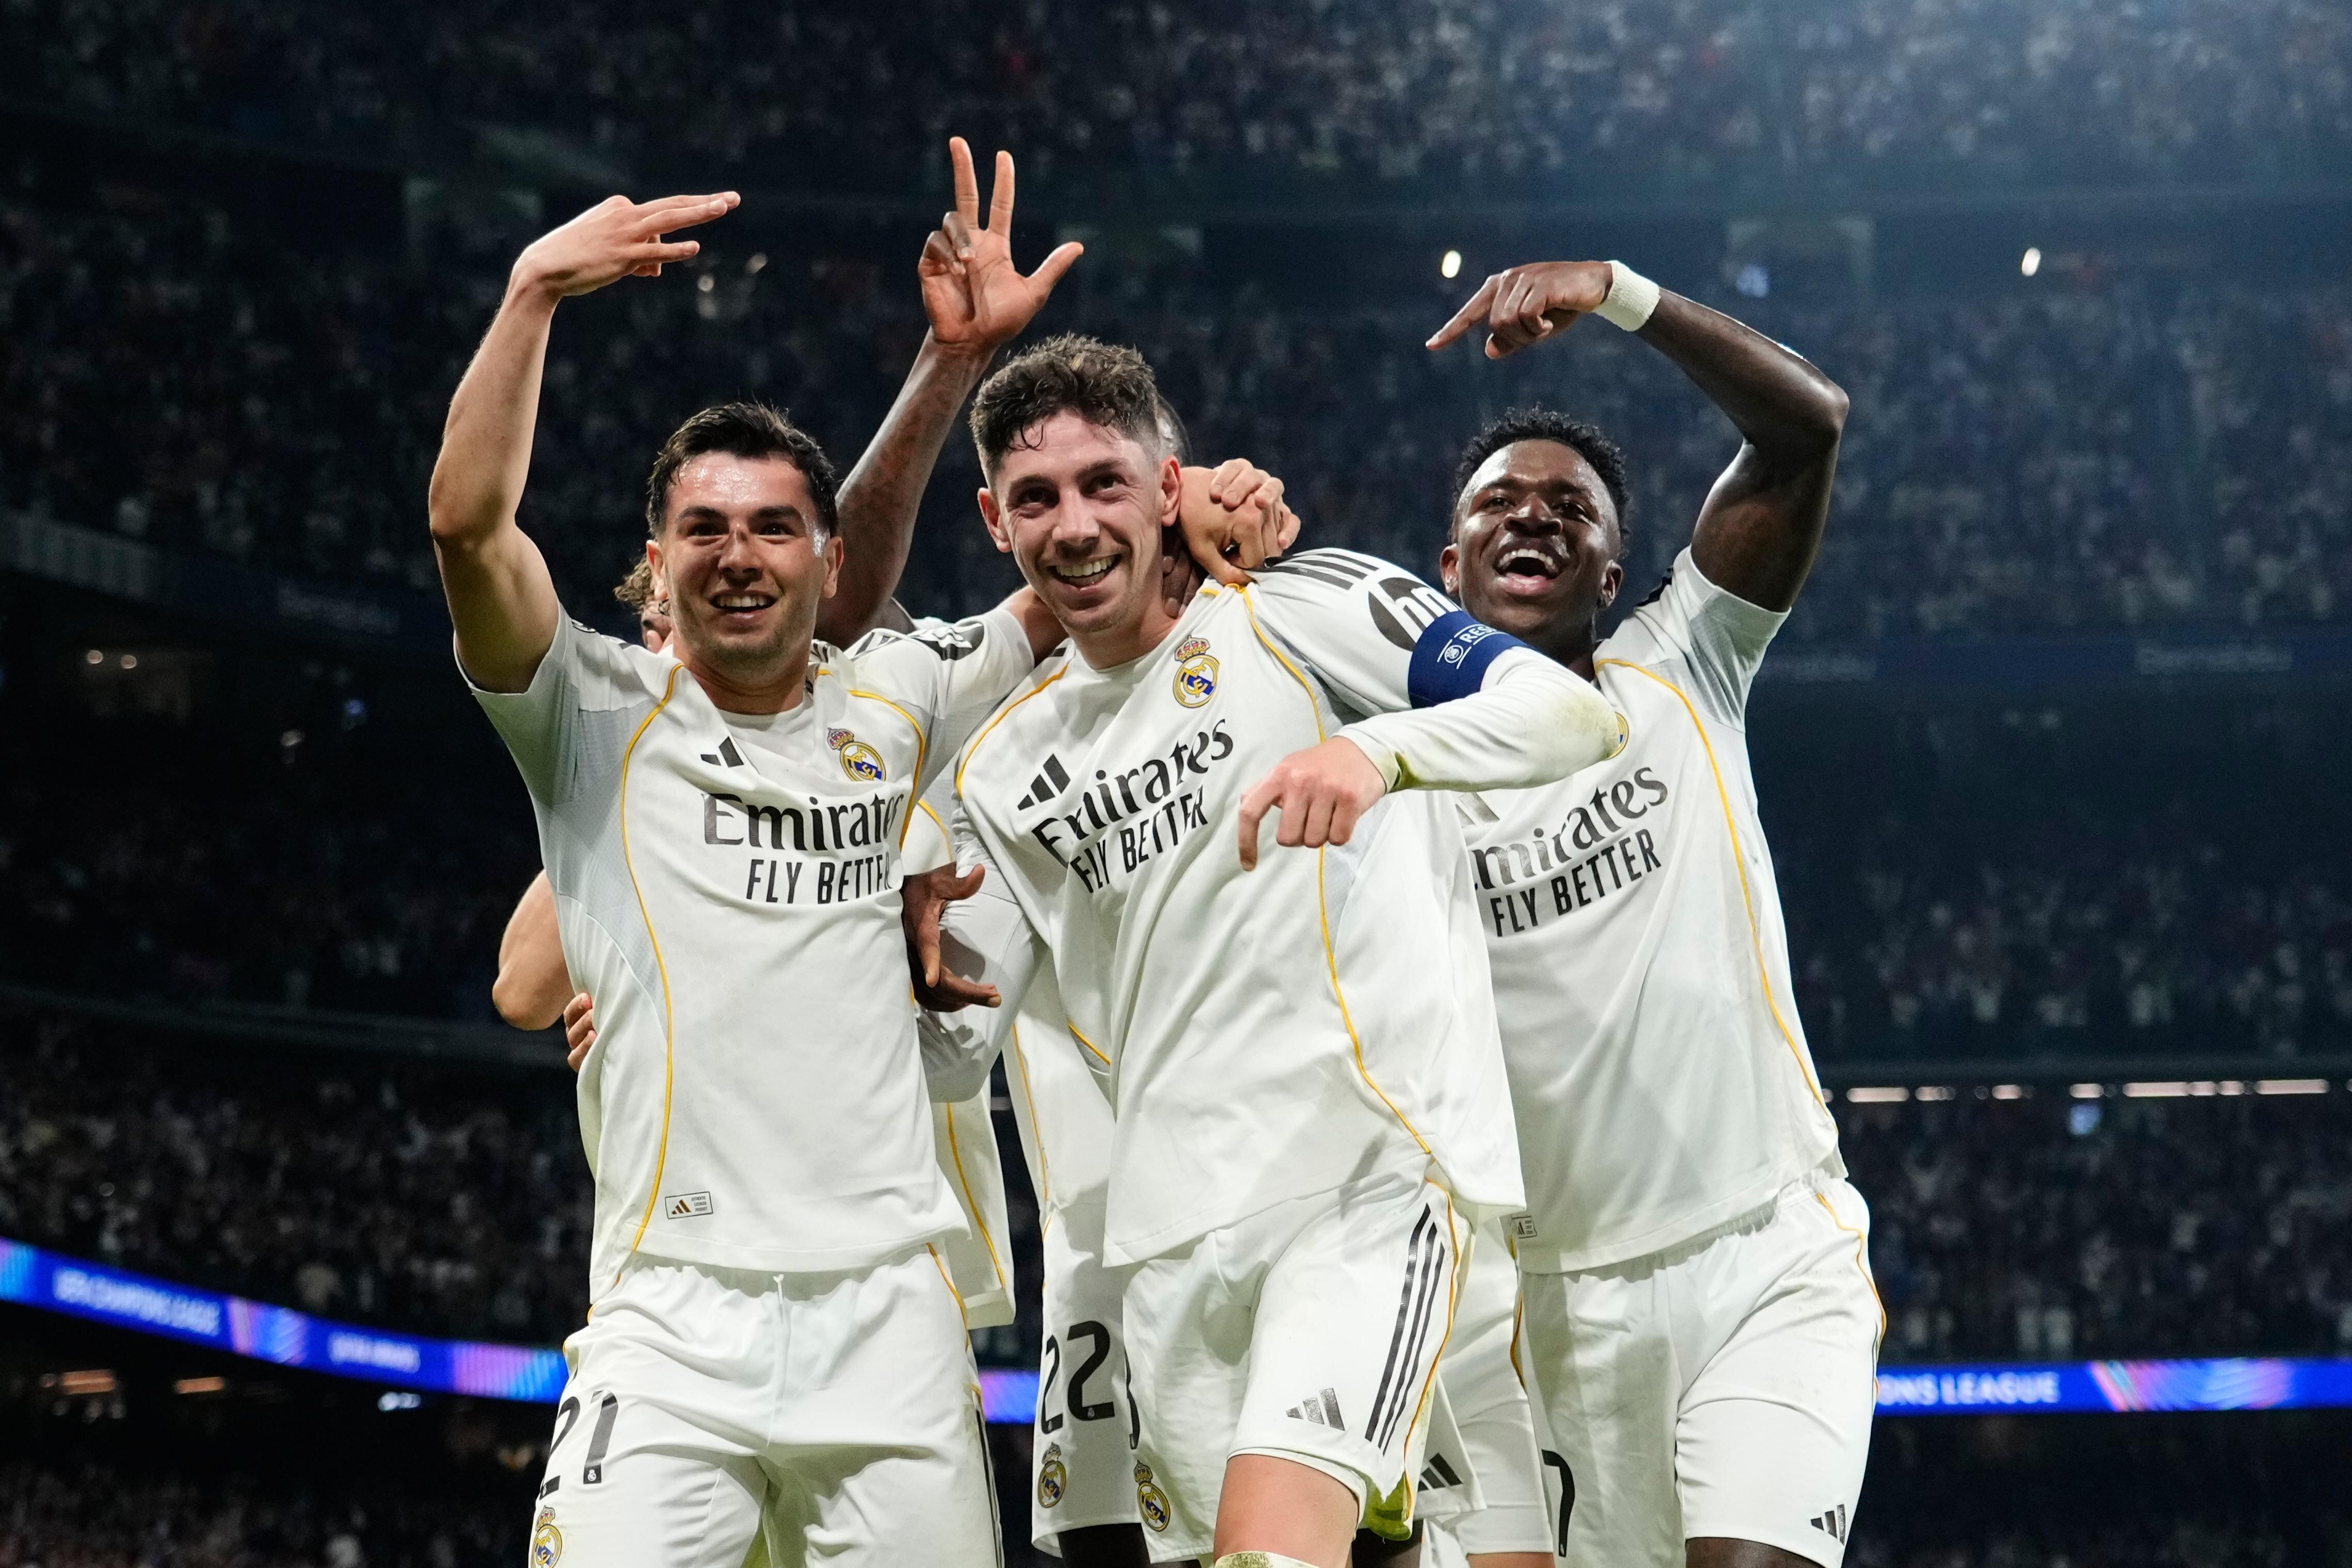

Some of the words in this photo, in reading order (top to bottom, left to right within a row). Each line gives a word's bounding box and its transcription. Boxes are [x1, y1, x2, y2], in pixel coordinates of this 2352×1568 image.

[1032, 719, 1233, 869] Emirates
[1070, 839, 1105, 893] FLY
[1120, 785, 1208, 873] BETTER
[1470, 767, 1668, 890] mirates
[746, 859, 803, 904] FLY
[1490, 888, 1538, 937] FLY
[1551, 829, 1661, 916] BETTER
[1041, 1321, 1116, 1435] 22
[1940, 1371, 2060, 1405] LEAGUE
[539, 1389, 619, 1500] 21
